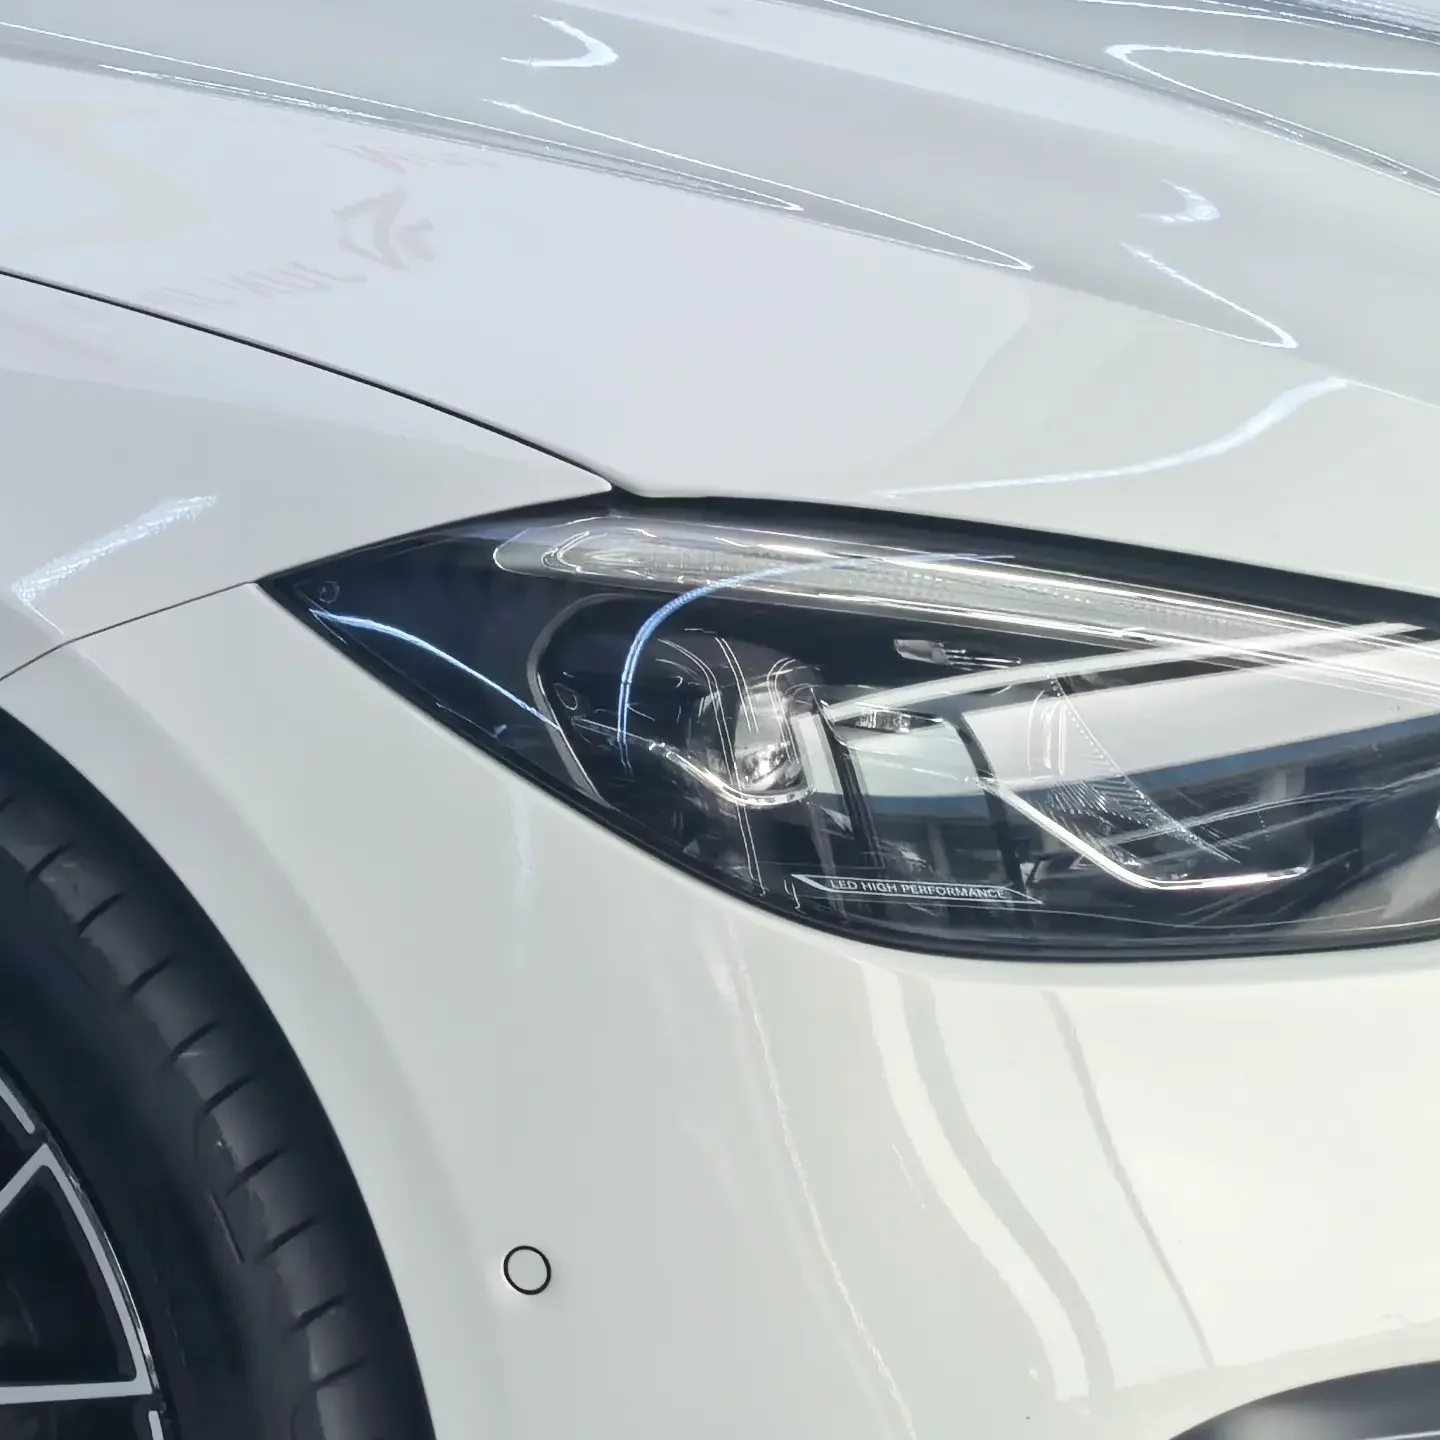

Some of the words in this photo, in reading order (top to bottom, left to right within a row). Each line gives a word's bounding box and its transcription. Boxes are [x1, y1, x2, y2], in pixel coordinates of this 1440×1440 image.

[829, 879, 859, 891] LED
[862, 879, 898, 893] HIGH
[900, 883, 1007, 900] PERFORMANCE
